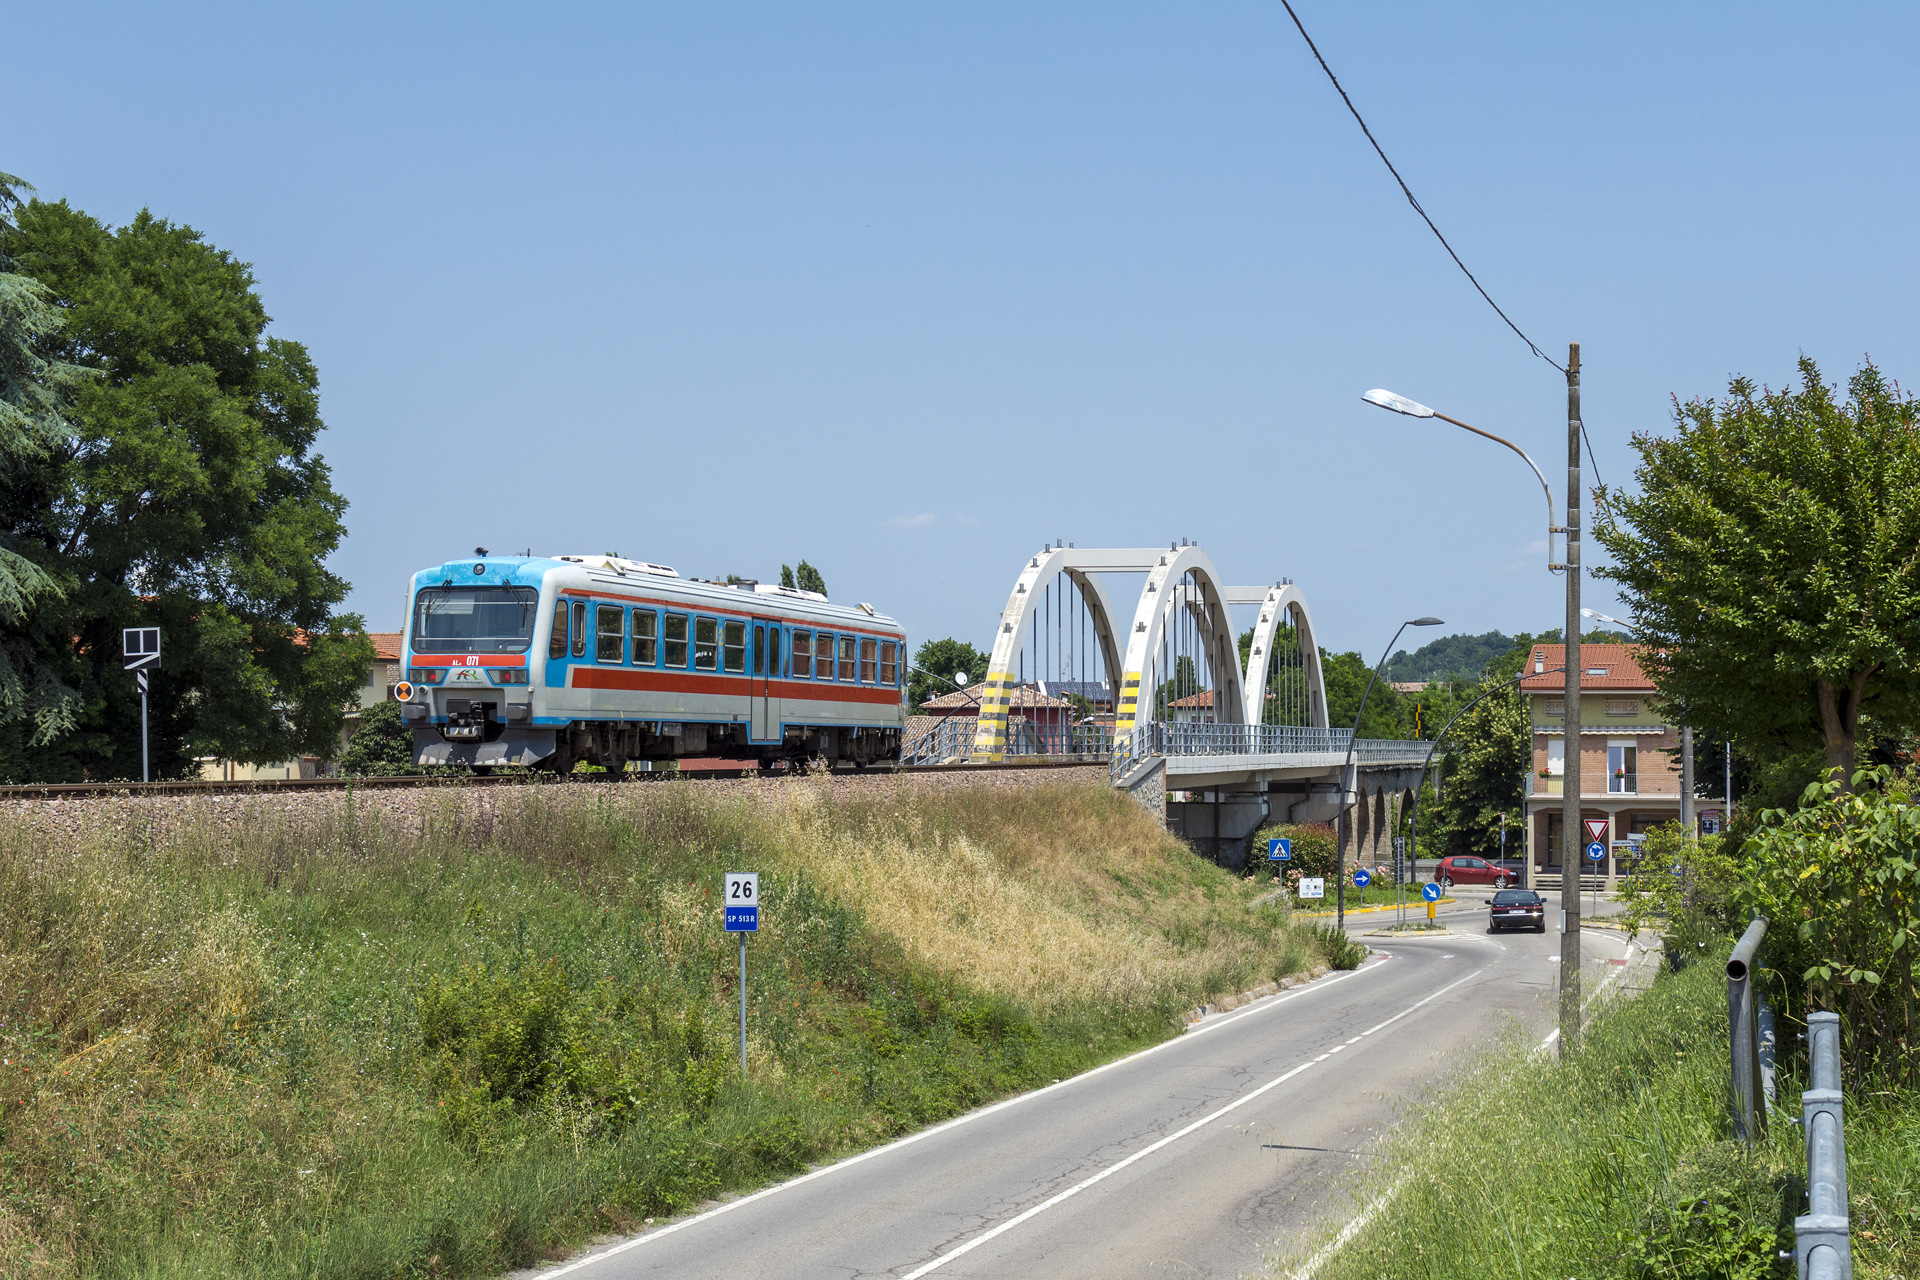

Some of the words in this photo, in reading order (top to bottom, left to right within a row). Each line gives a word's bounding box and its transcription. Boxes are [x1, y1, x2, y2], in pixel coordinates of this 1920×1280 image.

[718, 629, 723, 645] 2
[466, 655, 479, 666] 071
[731, 880, 753, 899] 26
[727, 915, 737, 923] SP
